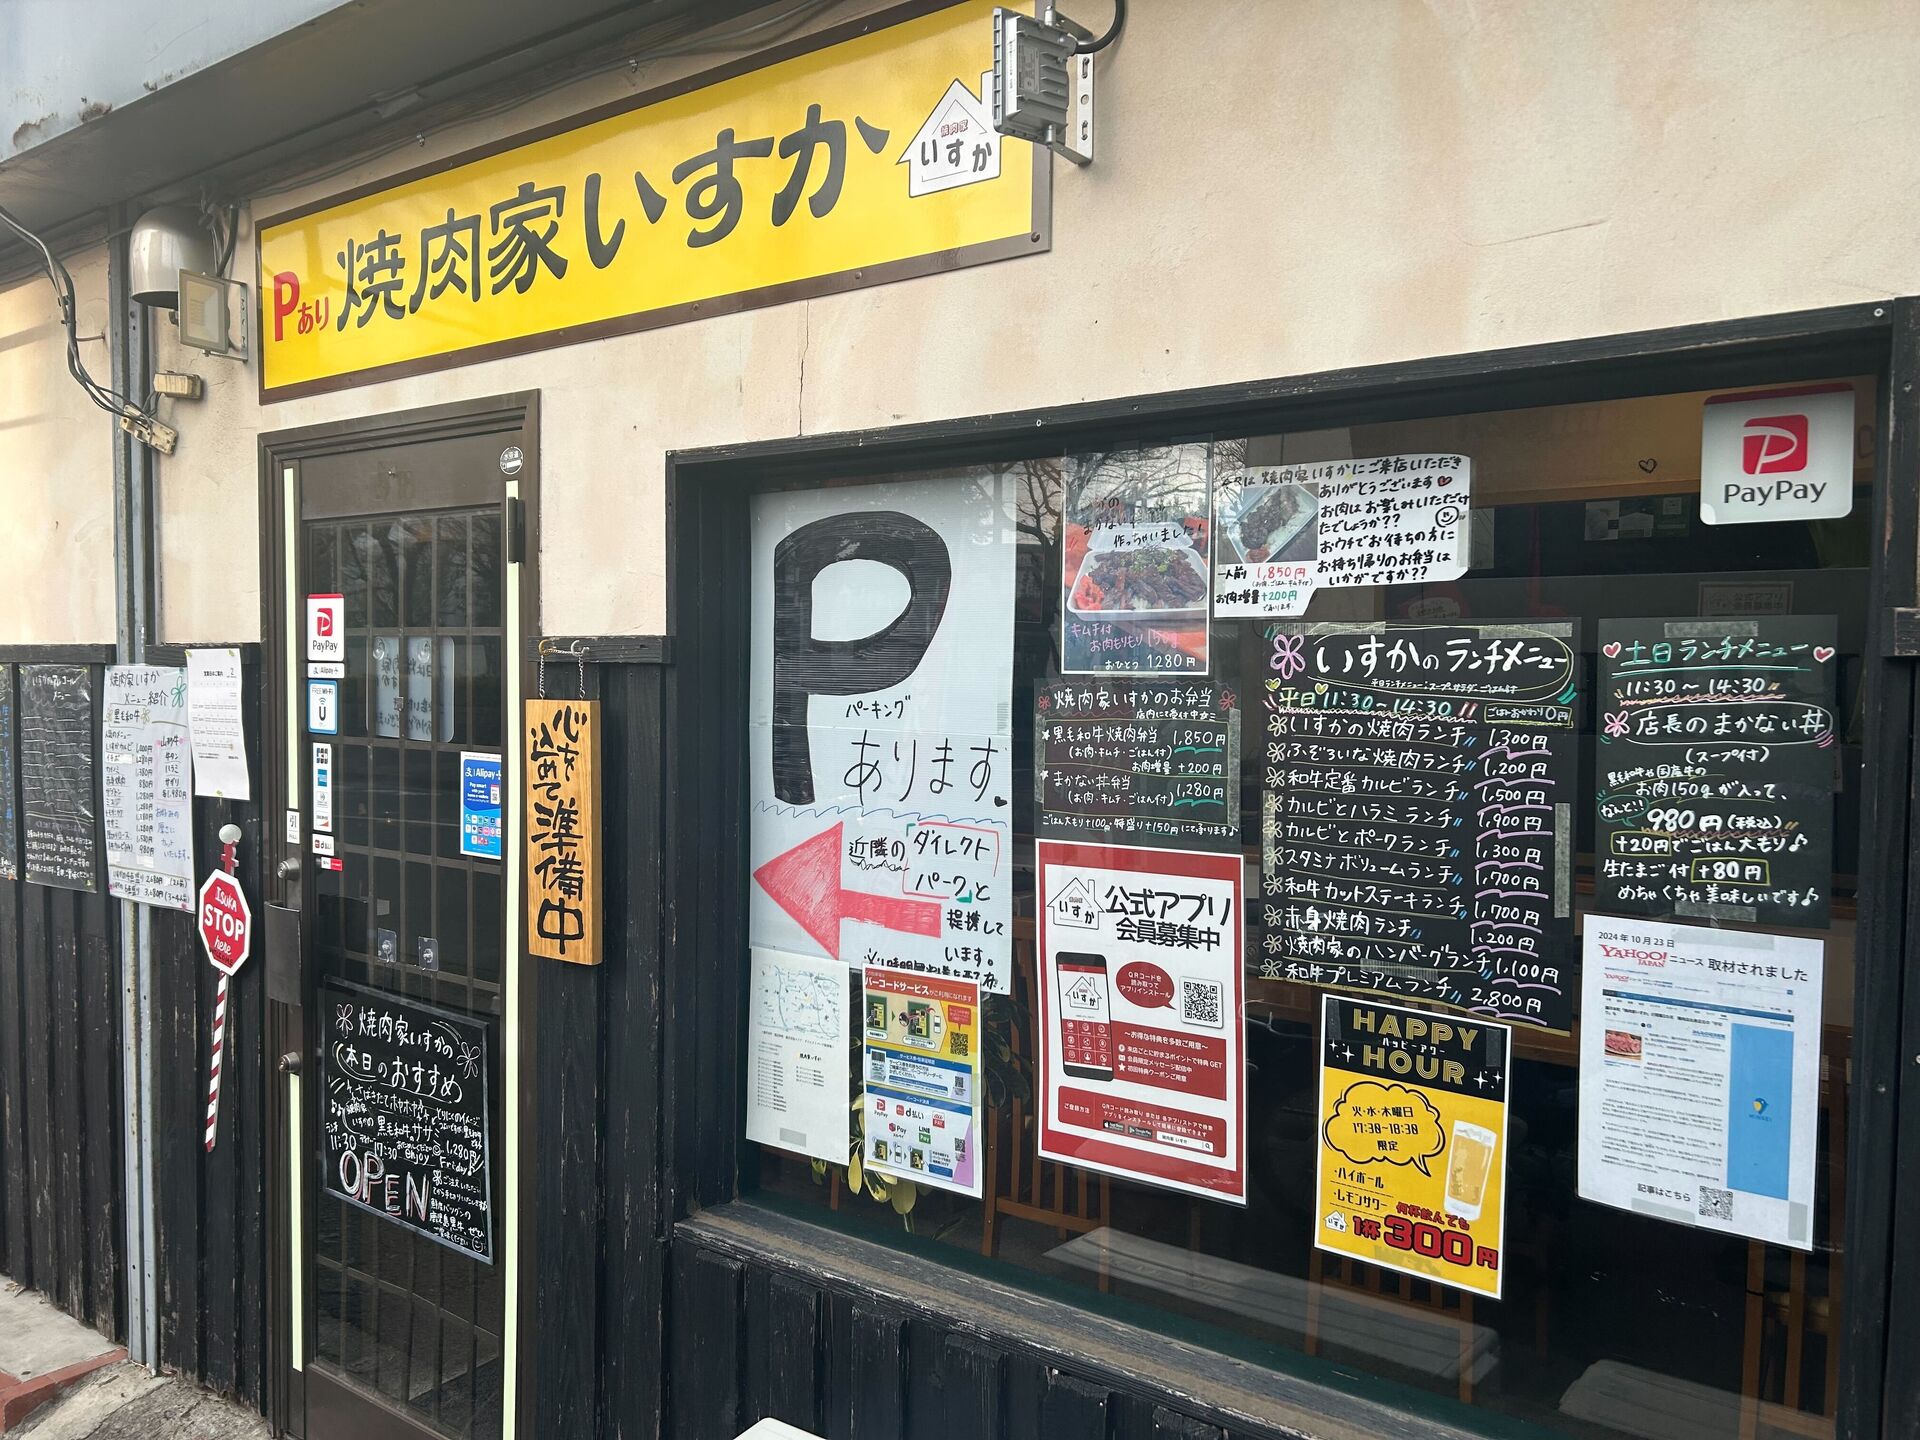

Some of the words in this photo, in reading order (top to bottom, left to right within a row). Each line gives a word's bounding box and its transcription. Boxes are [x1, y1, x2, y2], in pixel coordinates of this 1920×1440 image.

[920, 138, 993, 174] いすか
[337, 103, 890, 332] 焼肉家いすか
[1319, 475, 1433, 499] ありがとうございます
[1723, 480, 1828, 507] PayPay
[1320, 527, 1455, 554] おウチでお待ちの方に
[1217, 567, 1247, 580] 一人前
[1256, 566, 1306, 580] 1,850円
[1317, 550, 1452, 574] お持ち帰りのお弁当は
[1261, 590, 1298, 603] +200円
[1071, 623, 1112, 637] キムチ付
[312, 639, 338, 653] PayPay
[771, 510, 952, 807] P
[1620, 635, 1809, 666] 土日ランチメニュー
[845, 694, 912, 720] パーキング
[1053, 686, 1213, 711] 焼肉家いすかのお弁当
[1279, 687, 1315, 708] 平日
[1053, 725, 1159, 745] 黒毛和牛焼肉弁当
[1172, 729, 1227, 748] 1,850円
[1289, 714, 1466, 748] いすかの焼肉ランチ
[1488, 728, 1548, 750] 1,300円
[1635, 708, 1825, 737] 店長のまかない丼
[843, 729, 999, 807] あります
[1131, 760, 1173, 775] お肉増量
[1286, 741, 1465, 774] ふぞろいな焼肉ランチ
[1484, 758, 1547, 778] 1,200円
[1053, 770, 1132, 791] まかない丼弁当
[1175, 782, 1225, 799] 1,280円
[1287, 768, 1460, 801] 和牛定番カルビランチ
[1480, 786, 1546, 806] 1,500円
[1287, 796, 1453, 829] カルビとハラミランチ
[1477, 810, 1543, 831] 1,900円
[1646, 808, 1723, 832] 980円
[848, 835, 906, 862] 近隣の
[1286, 823, 1453, 858] カルビとポークランチ
[1475, 841, 1541, 864] 1,300円
[531, 796, 584, 956] 準備中
[1285, 849, 1454, 886] スタミナボリュームランチ
[1475, 868, 1540, 891] 1,700円
[1603, 859, 1690, 879] 生たまご付
[1698, 860, 1763, 881] +80円
[215, 886, 238, 913] ISUKA
[1058, 899, 1095, 925] いすか
[1103, 885, 1232, 926] 公式アプリ
[1285, 879, 1465, 918] 和牛カットステーキランチ
[1473, 901, 1540, 925] 1,700円
[204, 903, 245, 942] STOP
[946, 908, 1004, 937] 提携して
[1115, 916, 1221, 952] 会員募集中
[1285, 905, 1412, 938] 赤身焼肉ランチ
[1470, 928, 1535, 952] 1,200円
[214, 934, 232, 956] here
[1285, 936, 1490, 974] 焼肉家のハンバーグランチ
[1496, 958, 1560, 985] 1,100円
[1599, 943, 1668, 963] YAHOO!
[1669, 954, 1704, 967] ニュース
[1707, 957, 1809, 983] 取材されました
[1637, 958, 1666, 969] JAPAN
[1127, 970, 1162, 982] QRコードを
[1130, 978, 1159, 990] 読み取って
[1285, 962, 1453, 1002] 和牛プレミアムランチ
[1470, 987, 1542, 1013] 2,800円
[1071, 990, 1097, 1007] いすか
[358, 1005, 454, 1060] 焼肉家いすかの
[1351, 1007, 1479, 1052] HAPPY
[1381, 1036, 1447, 1056] ハッピーアワー
[345, 1044, 463, 1105] 本日のおすすめ
[1361, 1043, 1466, 1086] HOUR
[330, 1131, 358, 1151] 11:30
[374, 1140, 398, 1161] 17:30
[1376, 1139, 1400, 1153] 限定
[338, 1149, 430, 1223] OPEN
[1636, 1182, 1692, 1203] 記事はこちら
[1395, 1200, 1471, 1231] 何杯飲んでも
